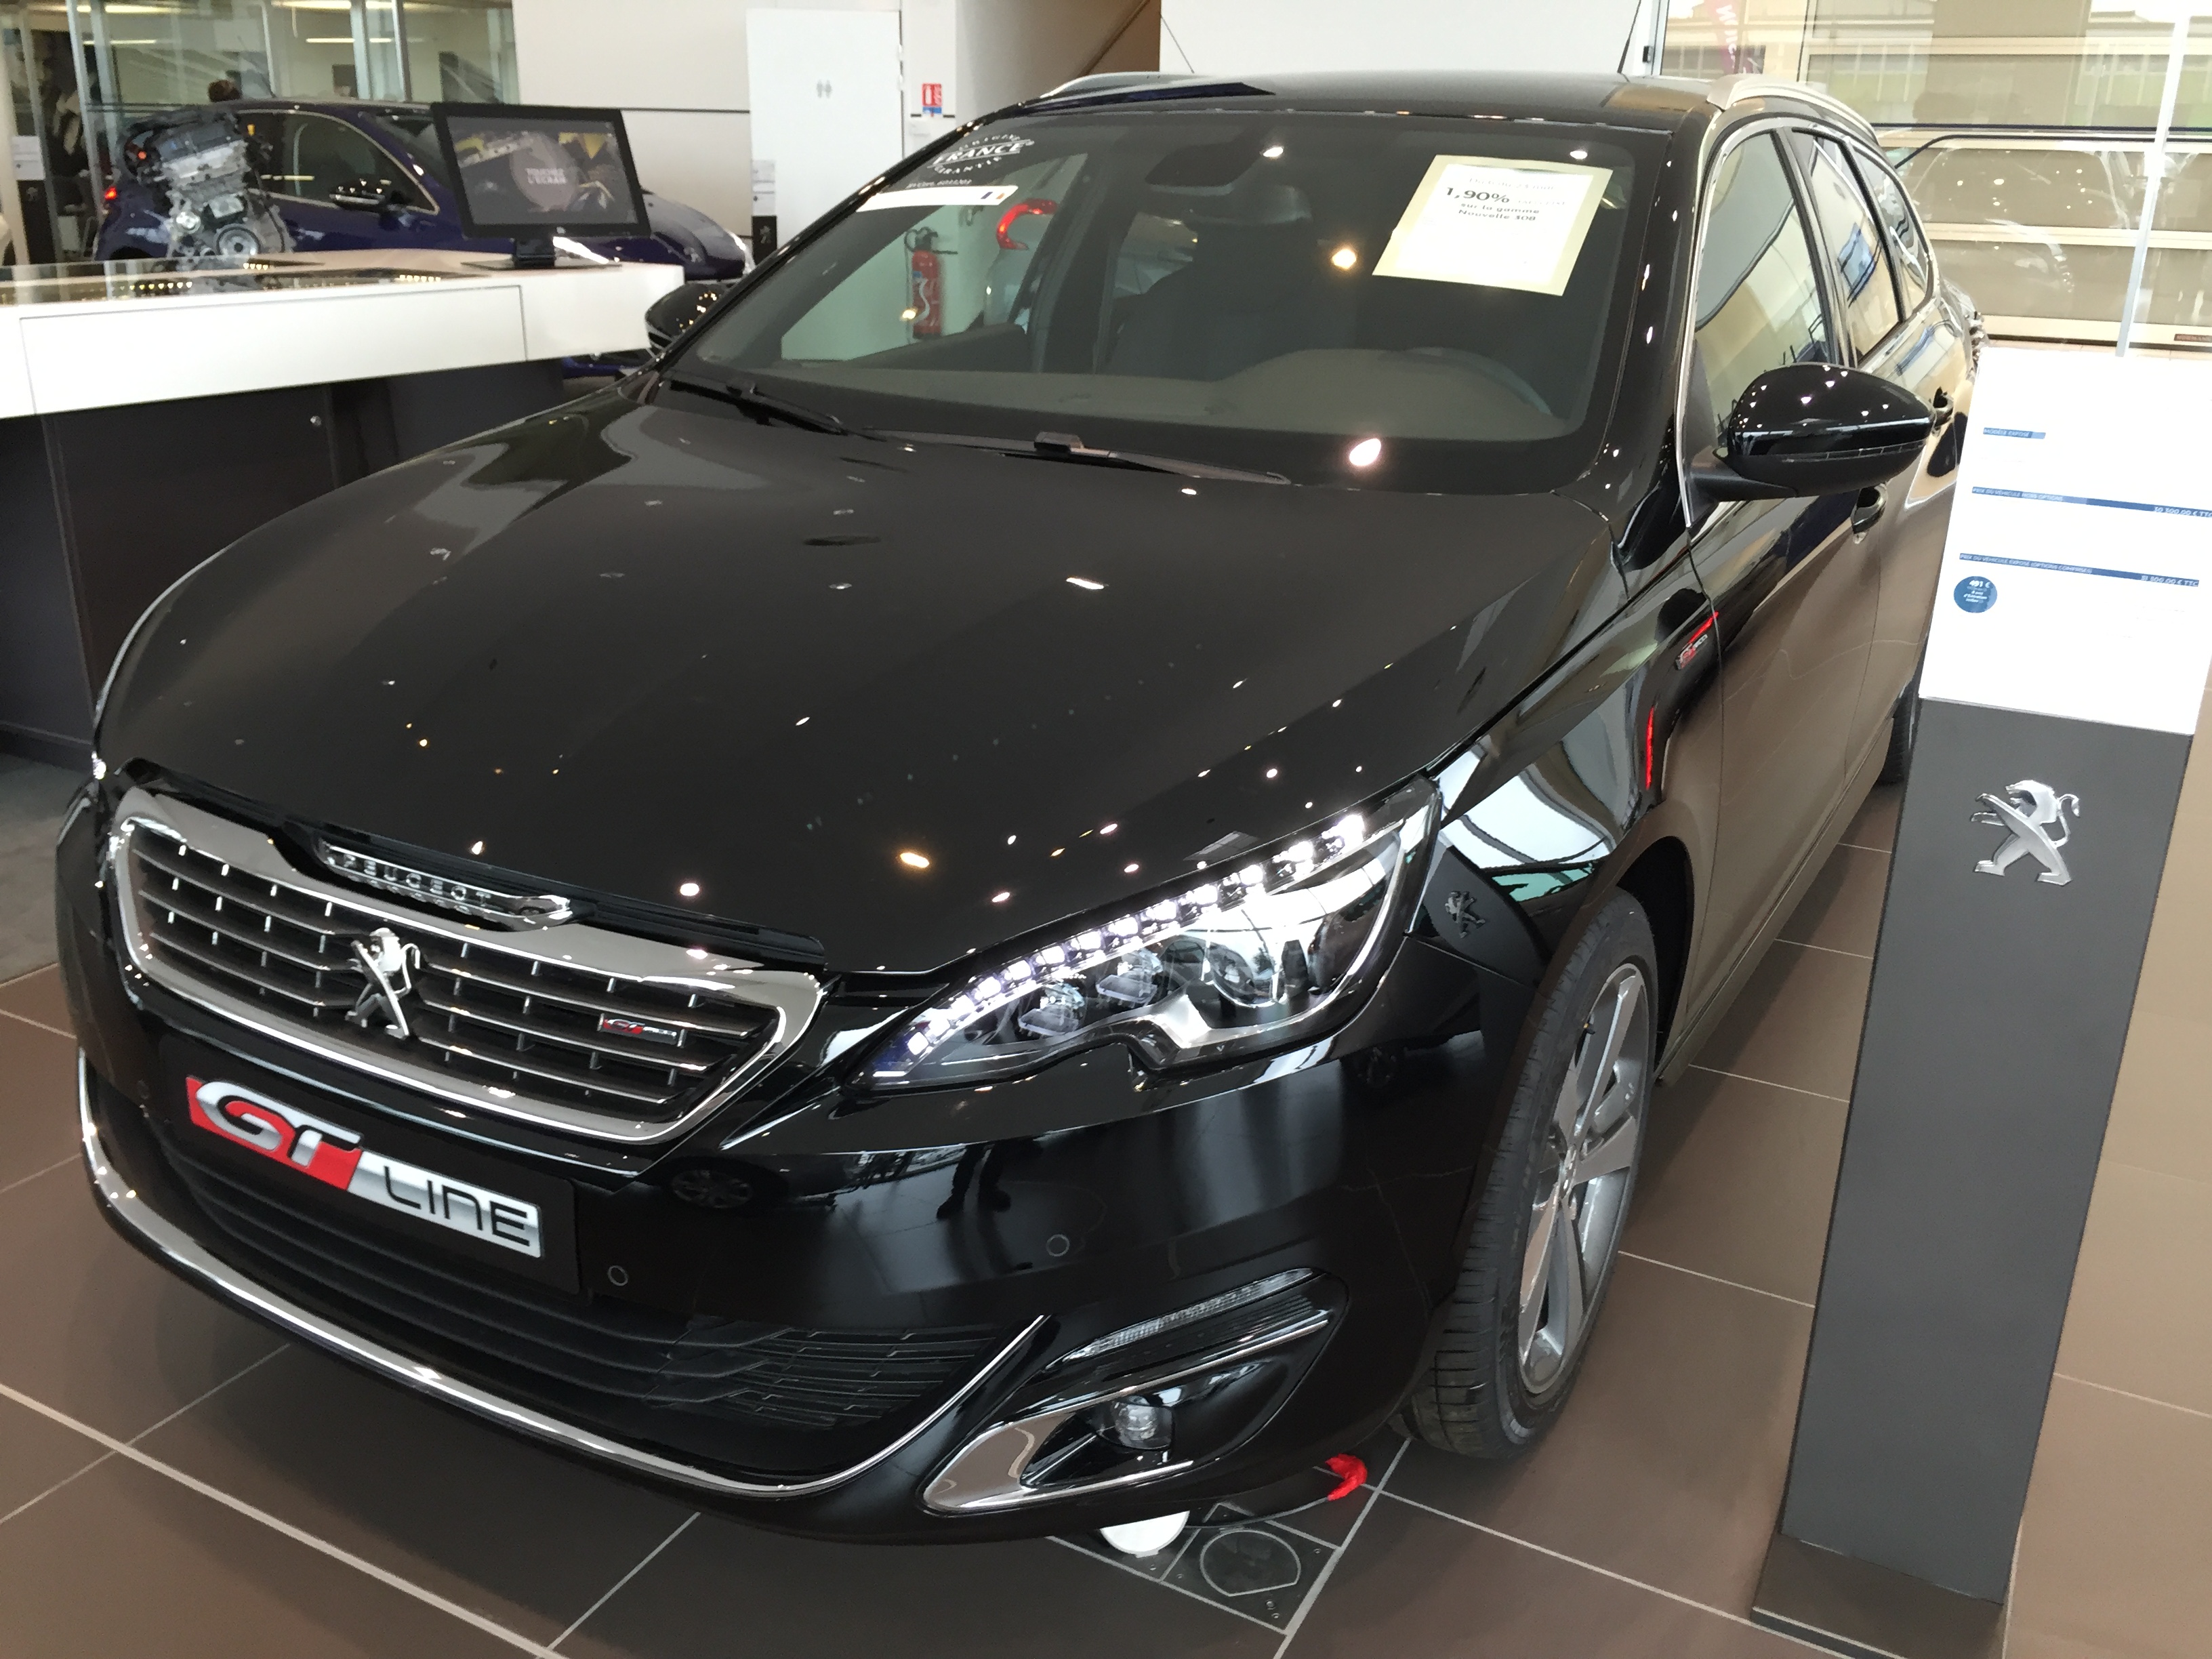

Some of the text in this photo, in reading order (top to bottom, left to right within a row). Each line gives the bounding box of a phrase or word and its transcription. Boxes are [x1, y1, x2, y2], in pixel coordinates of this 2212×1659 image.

[933, 142, 1023, 165] FRANCE
[1446, 187, 1510, 203] 1,90%
[1458, 209, 1510, 220] Nouvelle
[343, 853, 492, 907] PEUGEOT
[196, 1080, 531, 1247] GT LINE
